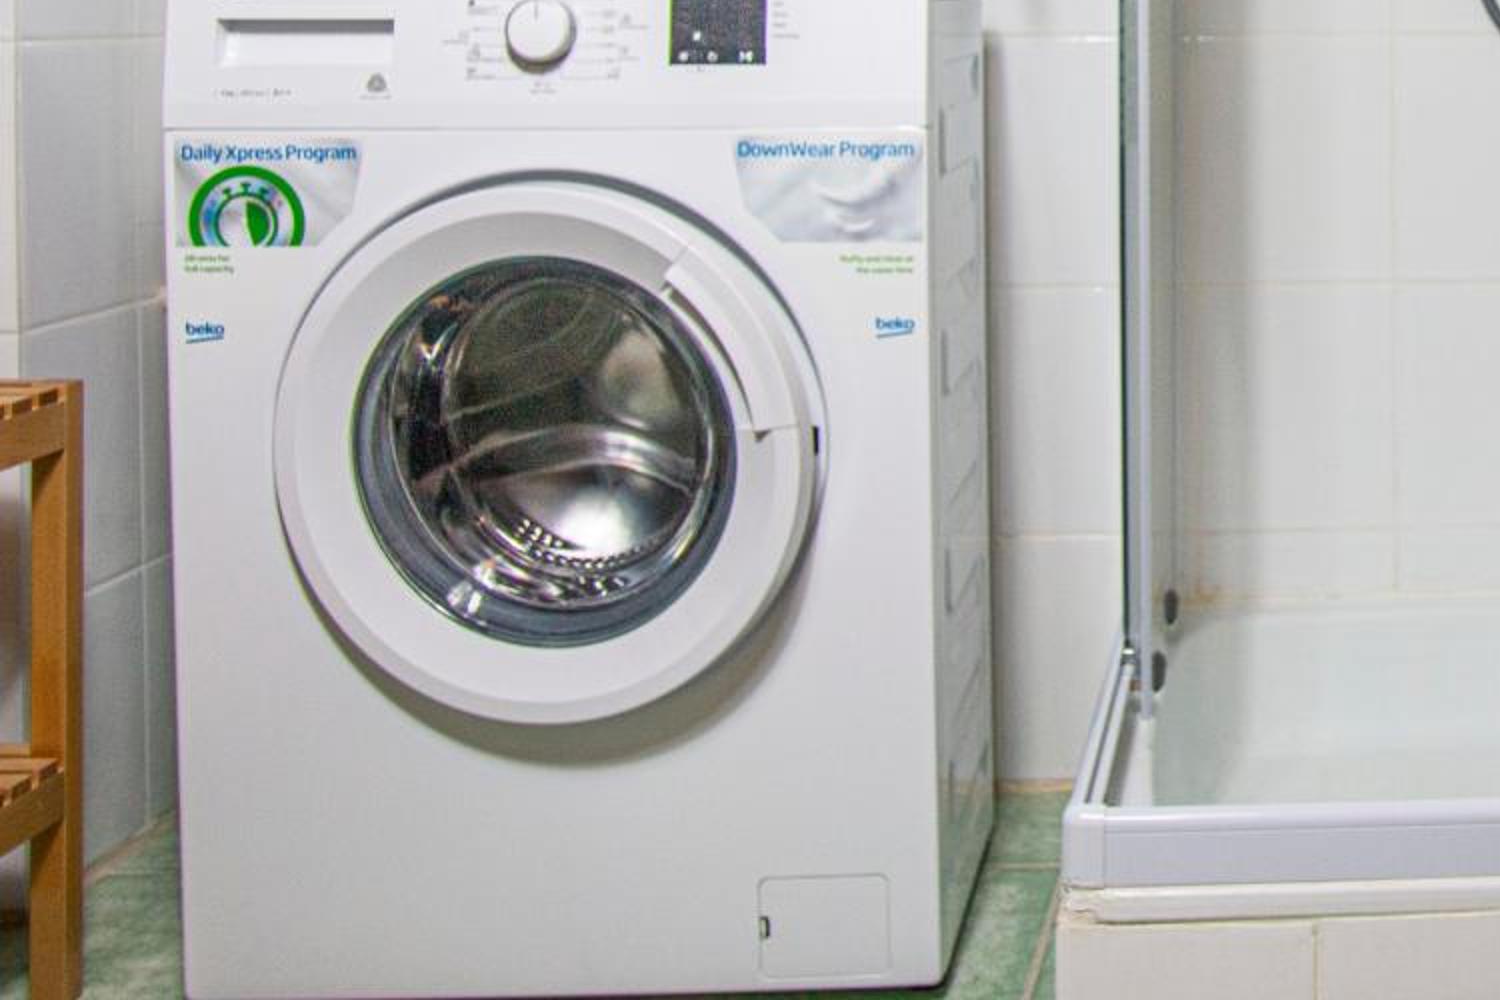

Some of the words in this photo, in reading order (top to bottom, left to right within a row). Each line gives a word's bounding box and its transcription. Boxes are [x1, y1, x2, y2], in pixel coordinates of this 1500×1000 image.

[181, 144, 222, 163] Daily
[225, 144, 283, 163] Xpress
[285, 144, 358, 163] Program
[736, 140, 834, 158] DownWear
[839, 140, 915, 160] Program
[185, 321, 225, 336] beko
[875, 316, 916, 330] beko
